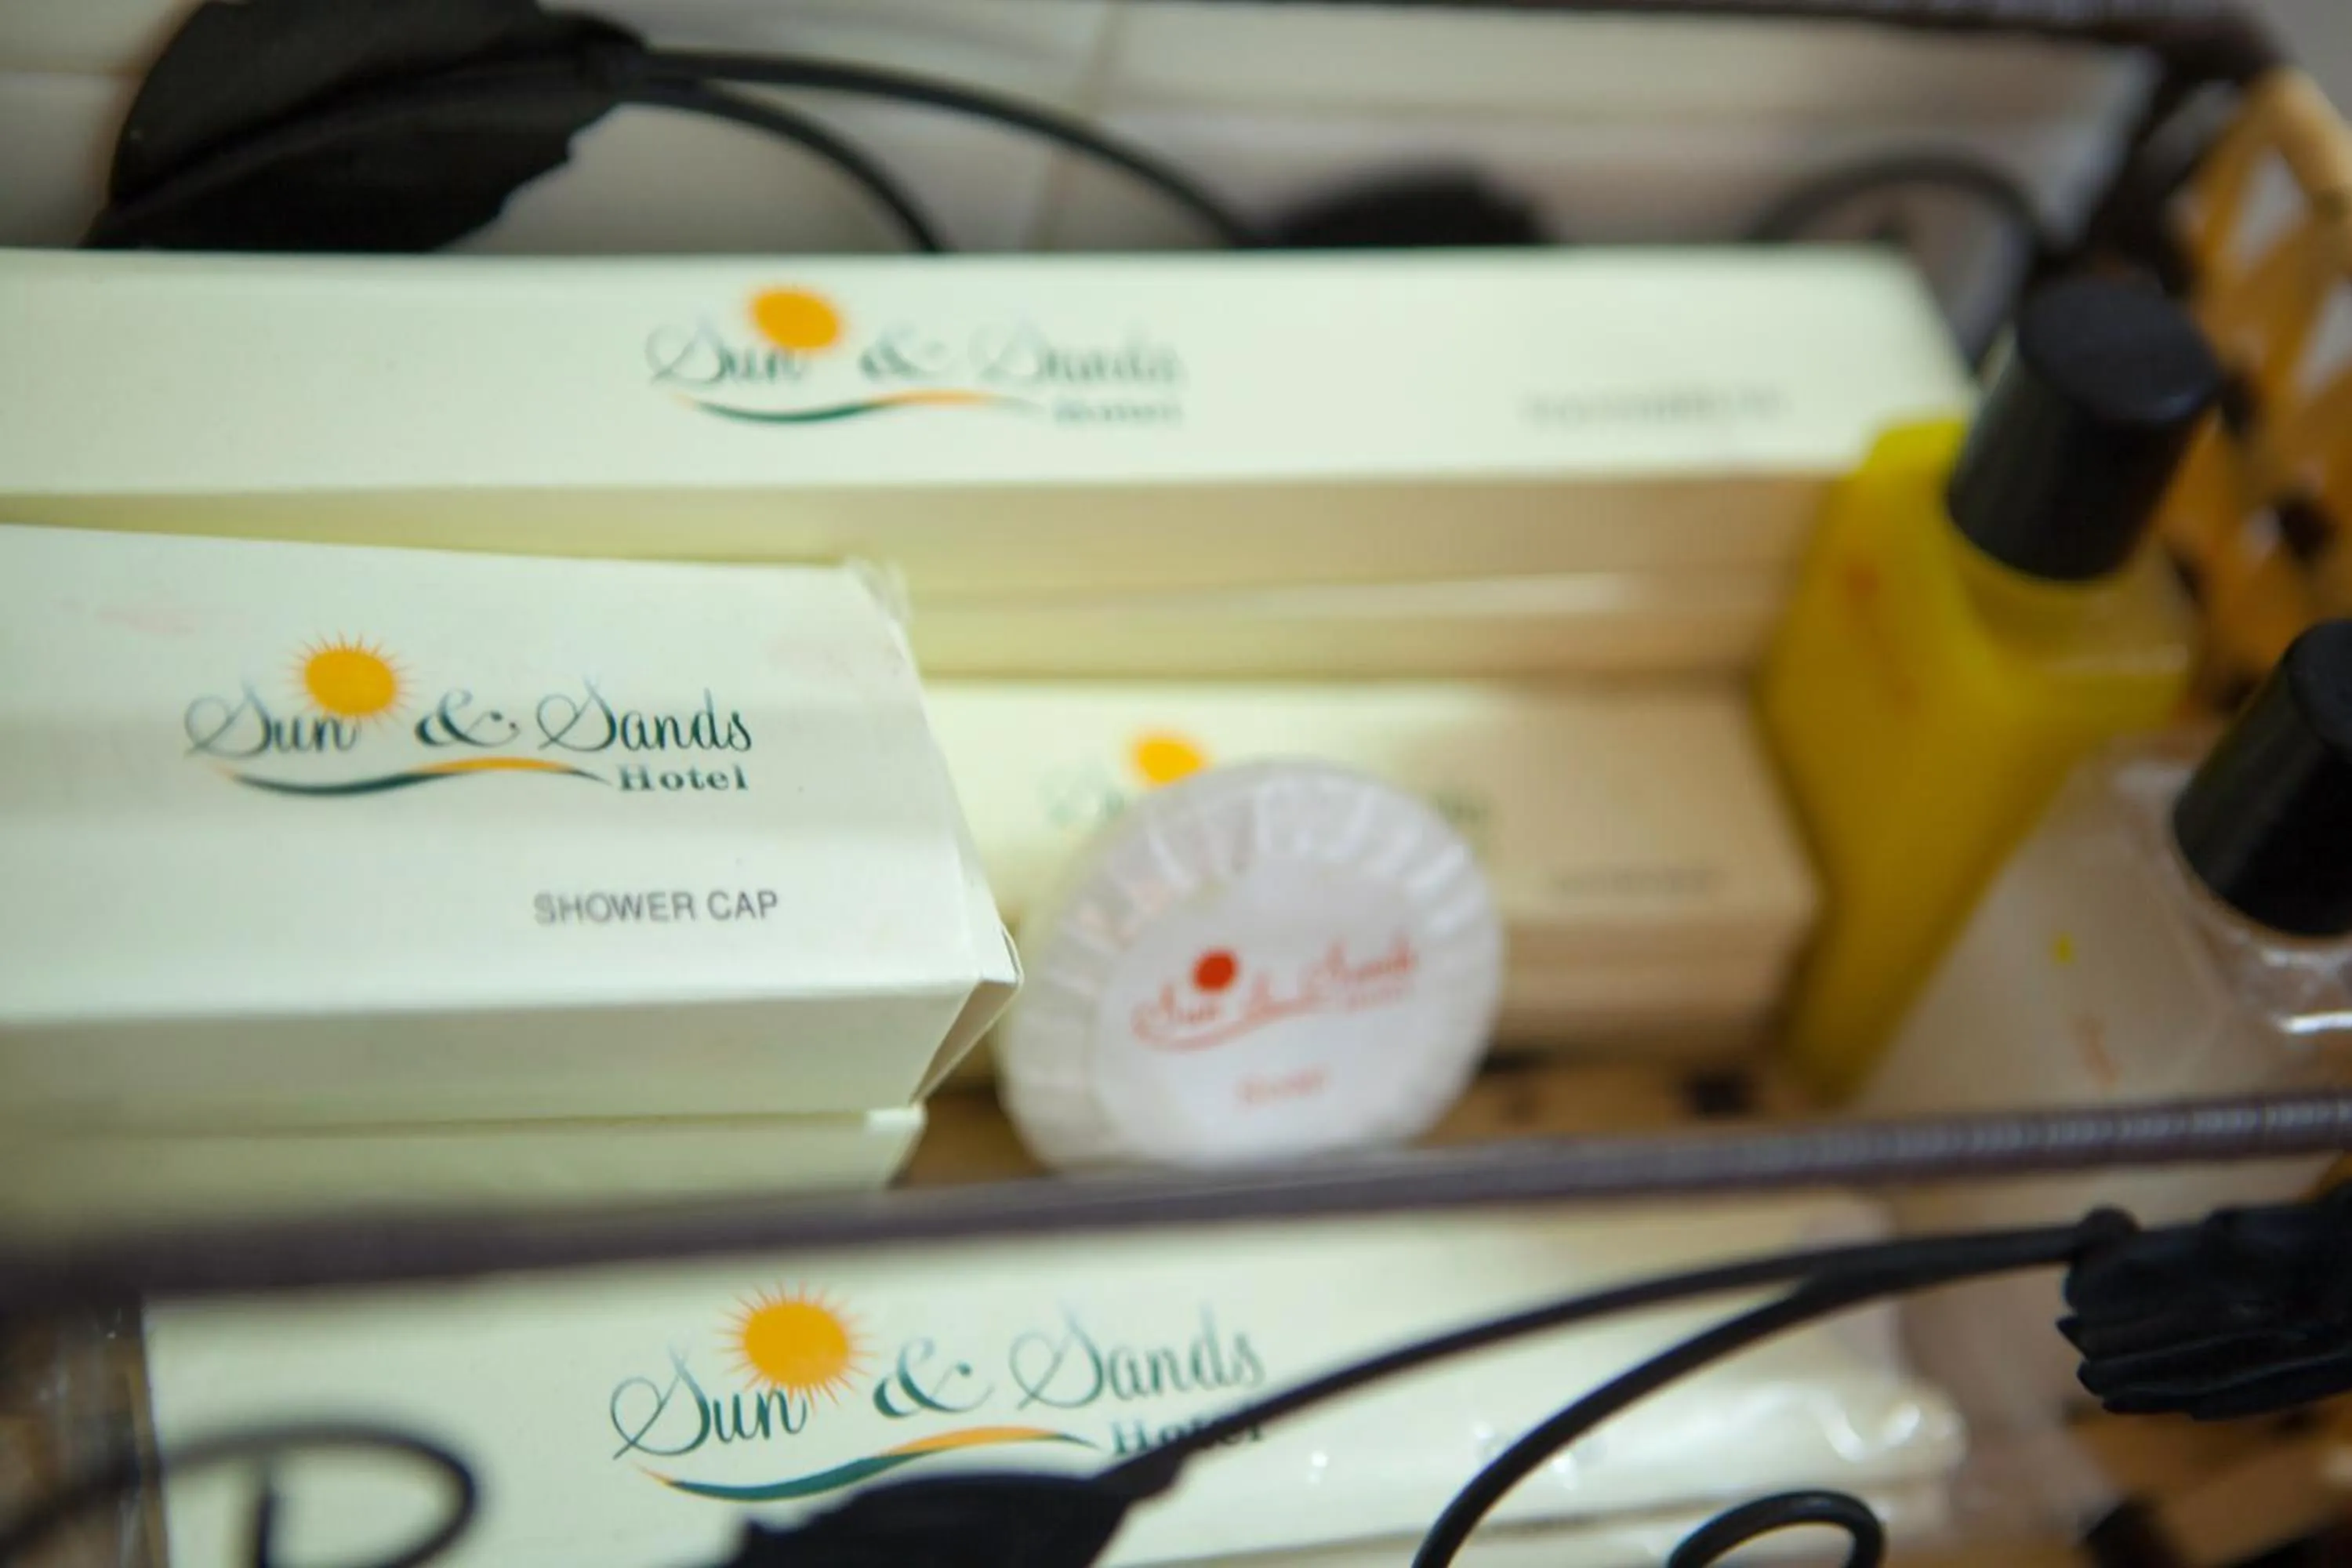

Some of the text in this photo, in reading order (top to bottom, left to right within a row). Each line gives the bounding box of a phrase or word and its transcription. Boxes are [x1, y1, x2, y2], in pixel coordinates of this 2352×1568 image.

[644, 310, 805, 387] Sun
[858, 320, 958, 382] &
[183, 674, 753, 760] Sun & Sands
[618, 763, 750, 793] Hotel
[533, 888, 779, 926] SHOWER CAP
[611, 1301, 1266, 1461] Sun & Sands
